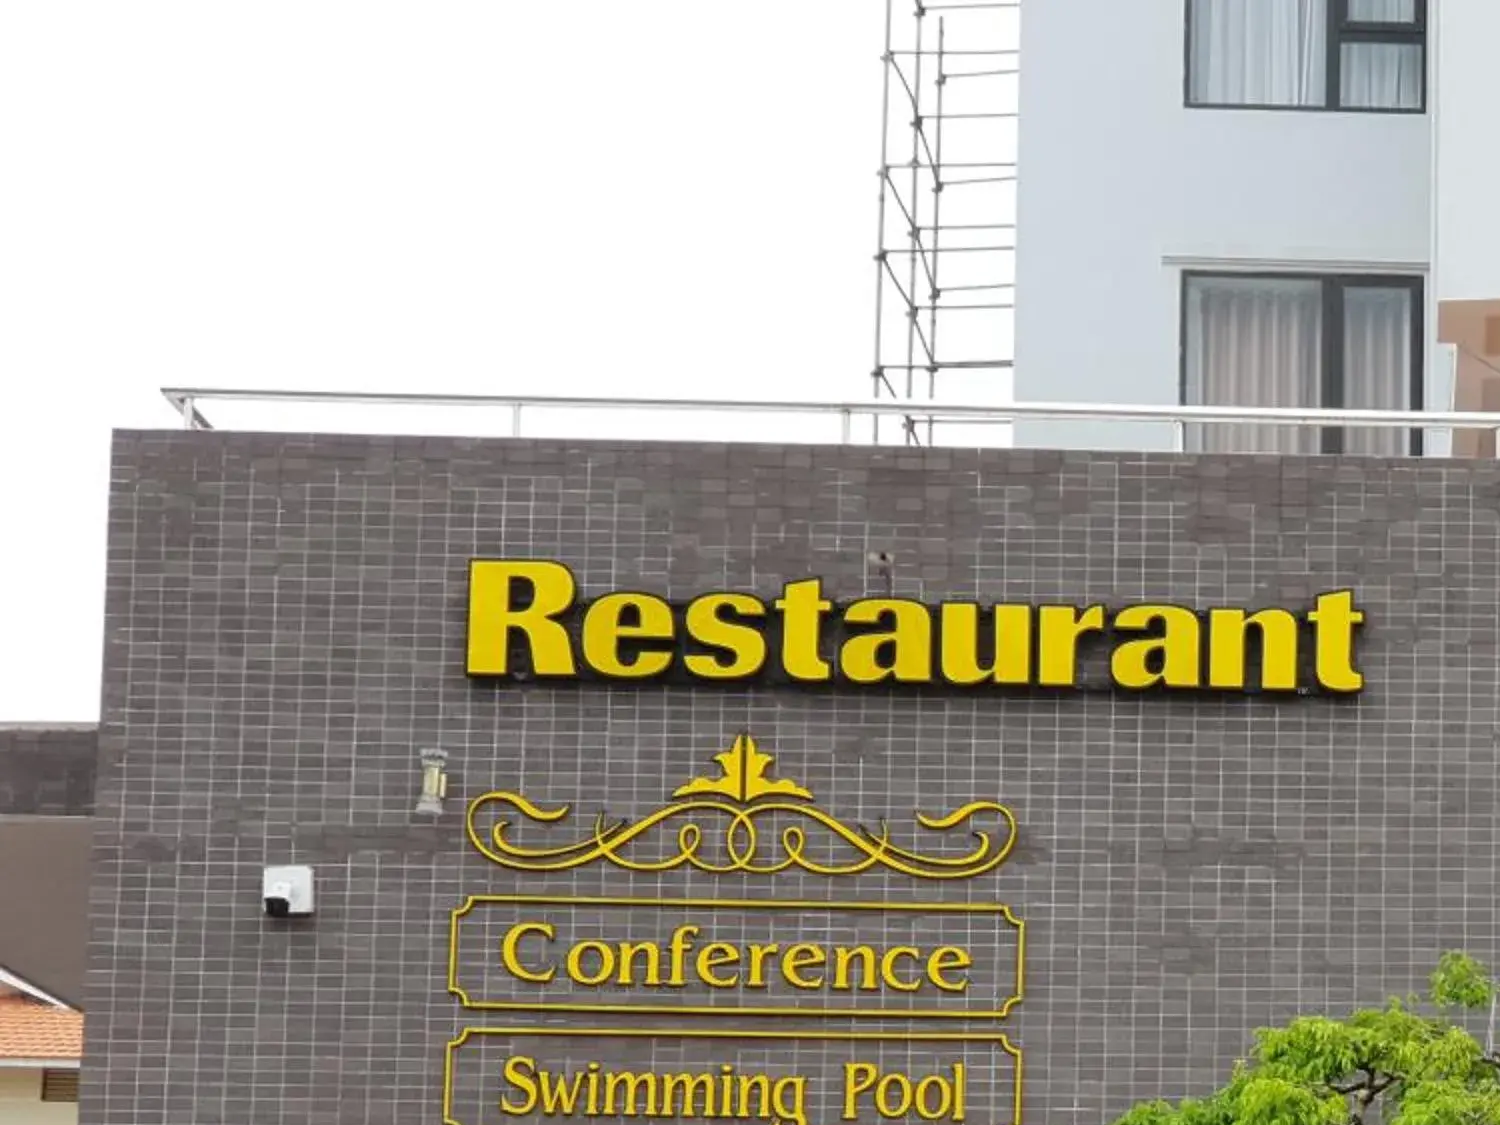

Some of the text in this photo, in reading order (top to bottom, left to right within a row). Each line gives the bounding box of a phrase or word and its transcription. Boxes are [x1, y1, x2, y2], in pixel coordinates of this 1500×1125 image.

[465, 559, 1364, 693] Restaurant
[500, 920, 974, 993] Conference
[843, 1061, 966, 1122] Pool
